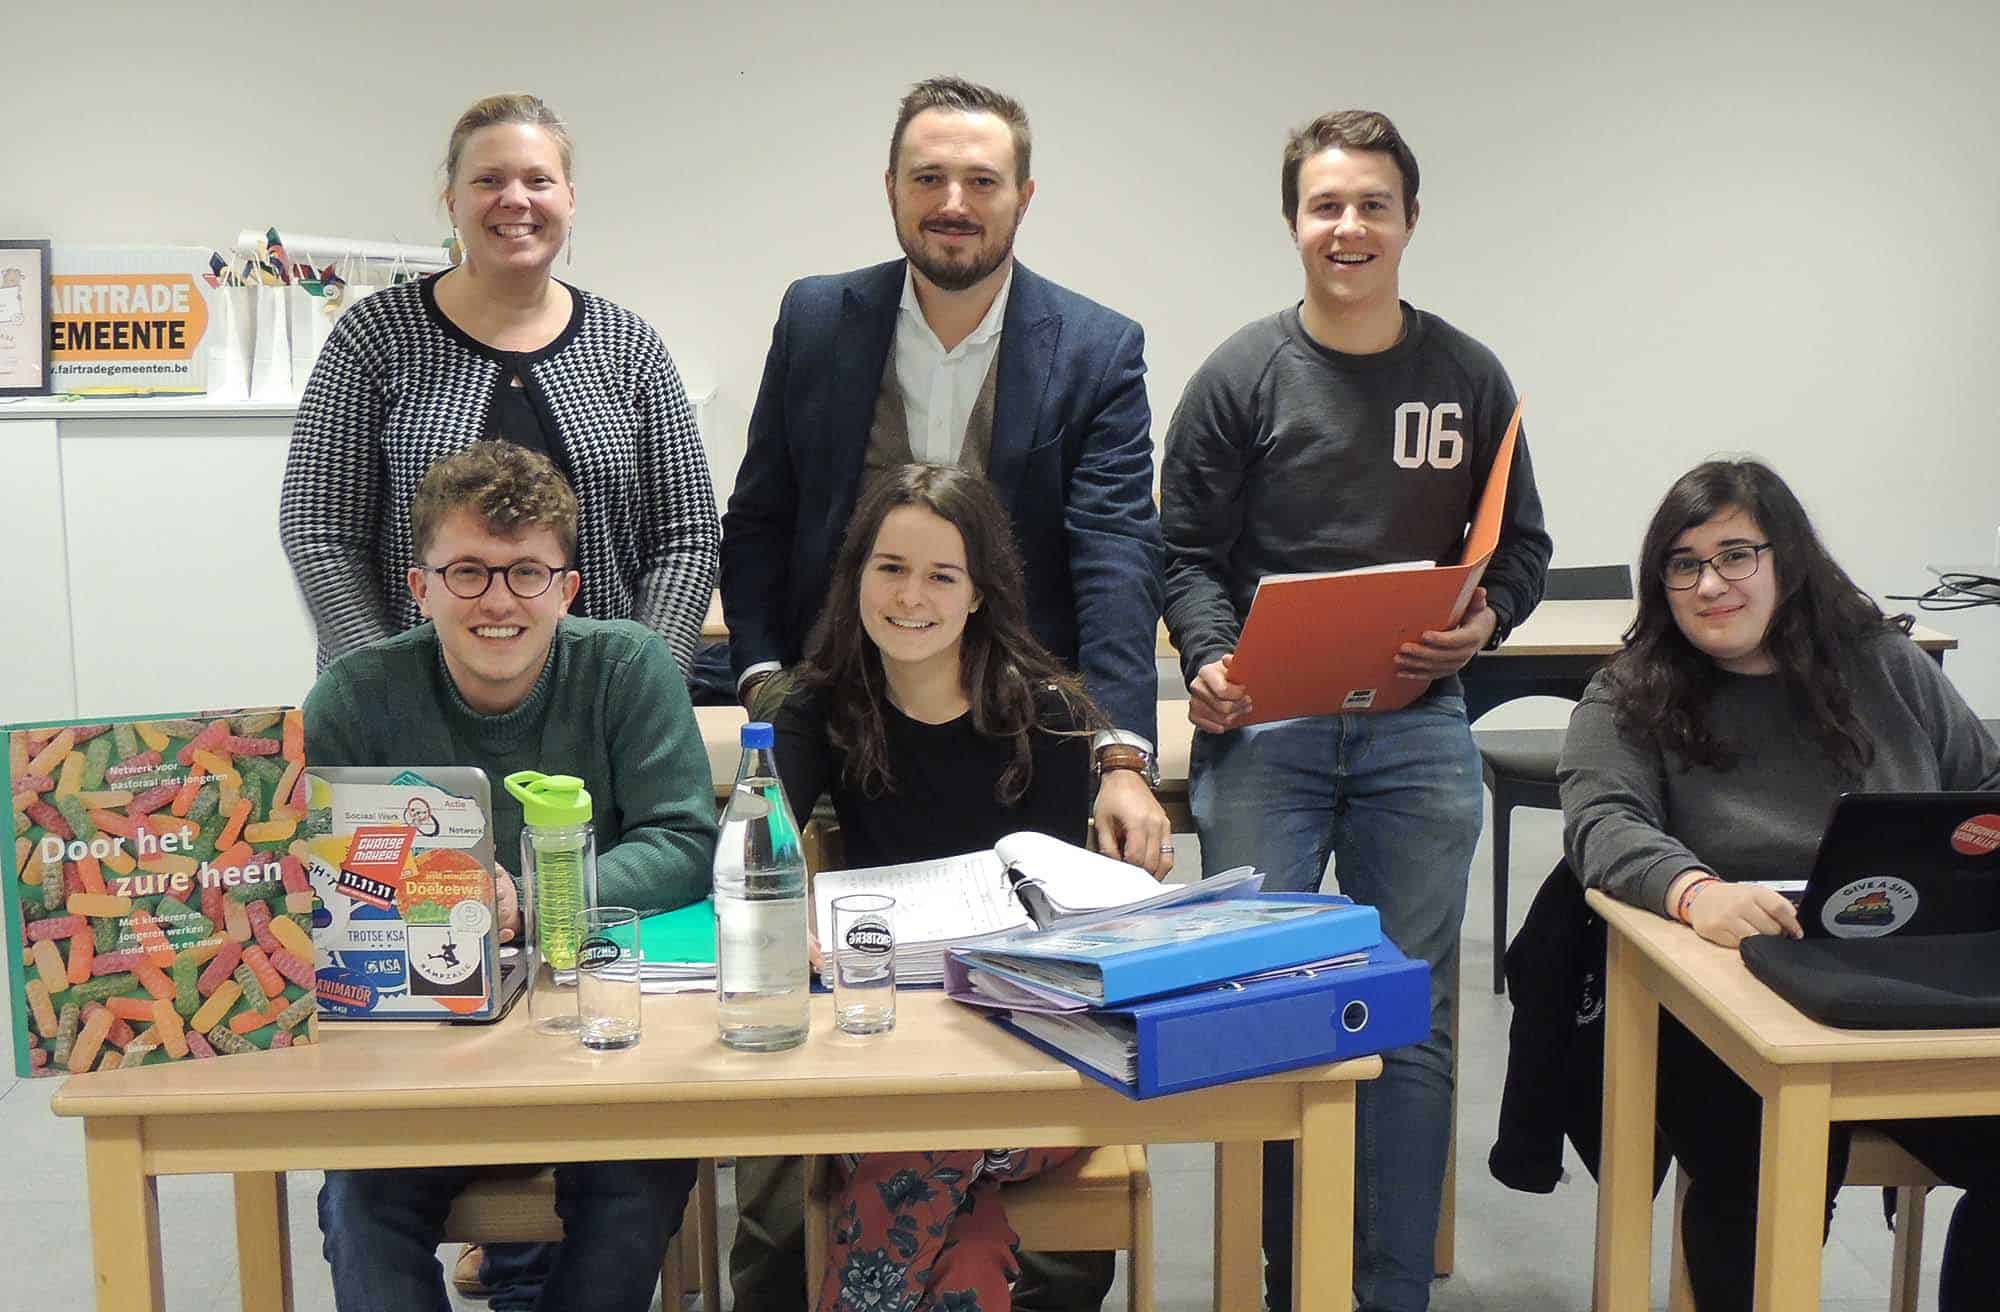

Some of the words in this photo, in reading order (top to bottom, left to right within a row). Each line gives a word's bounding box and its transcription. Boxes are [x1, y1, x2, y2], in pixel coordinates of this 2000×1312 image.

[51, 284, 190, 314] AIRTRADE
[51, 321, 185, 350] EMEENTE
[50, 364, 188, 376] .fairtradegemeenten.be
[1393, 402, 1463, 469] 06
[110, 763, 152, 777] Netwerk
[155, 761, 178, 772] voor
[163, 777, 181, 787] met
[183, 772, 228, 787] jongeren
[42, 837, 126, 863] Door
[138, 825, 194, 854] het
[116, 871, 190, 898] zure
[201, 860, 283, 889] heen
[344, 874, 392, 898] 11.11.11
[1843, 882, 1875, 896] GIVE
[119, 916, 143, 928] Met
[145, 912, 186, 926] kinderen
[119, 928, 164, 943] jongeren
[166, 924, 204, 936] werken
[348, 929, 383, 942] TROTSE
[386, 929, 405, 941] KSA
[379, 958, 401, 972] KSA
